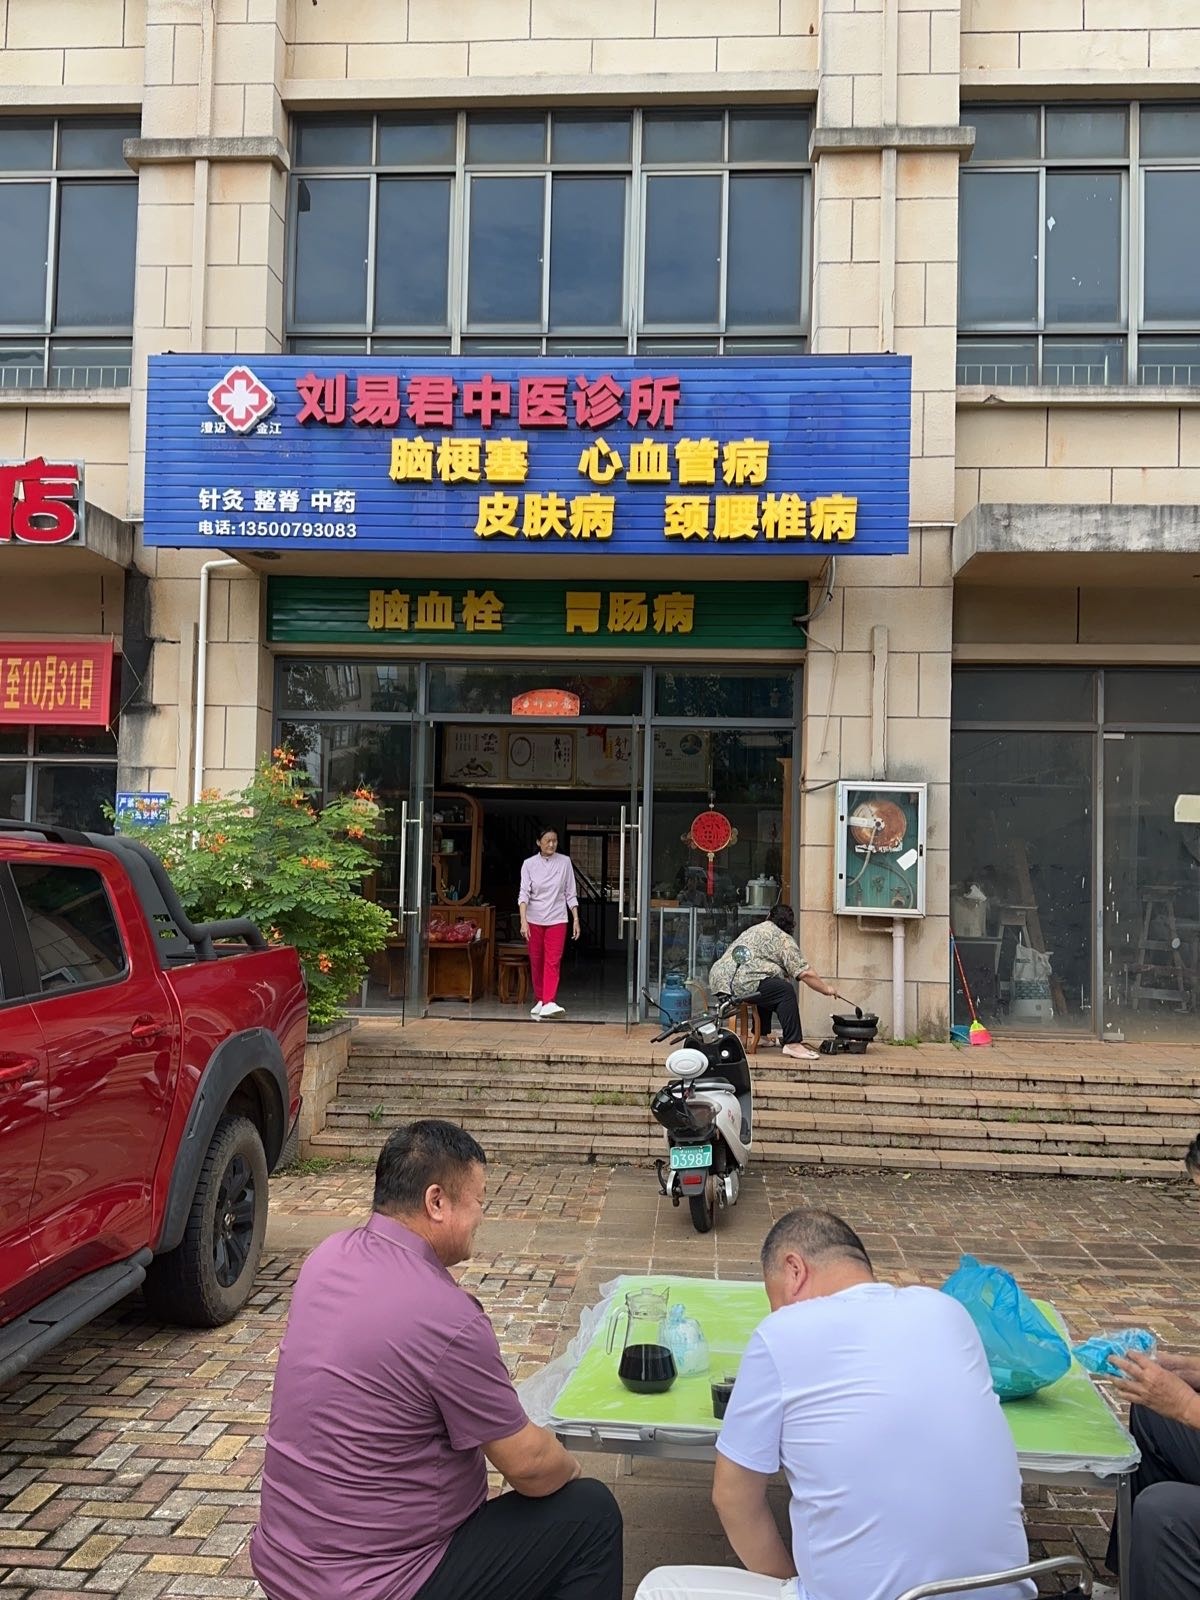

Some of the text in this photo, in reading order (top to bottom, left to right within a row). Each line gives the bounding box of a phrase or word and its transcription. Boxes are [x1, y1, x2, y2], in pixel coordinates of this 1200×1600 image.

[296, 373, 680, 430] 刘易君中医诊所
[256, 421, 283, 435] 金江
[389, 437, 769, 486] 脑梗塞 心血管病
[198, 488, 356, 515] 针灸 整脊 中药
[474, 491, 858, 543] 皮肤病 颈腰椎病
[197, 519, 358, 539] 电话:13500793083
[367, 589, 696, 635] 脑血栓 胃肠病
[0, 655, 94, 711] 至10月31日
[672, 1152, 711, 1167] D3987
